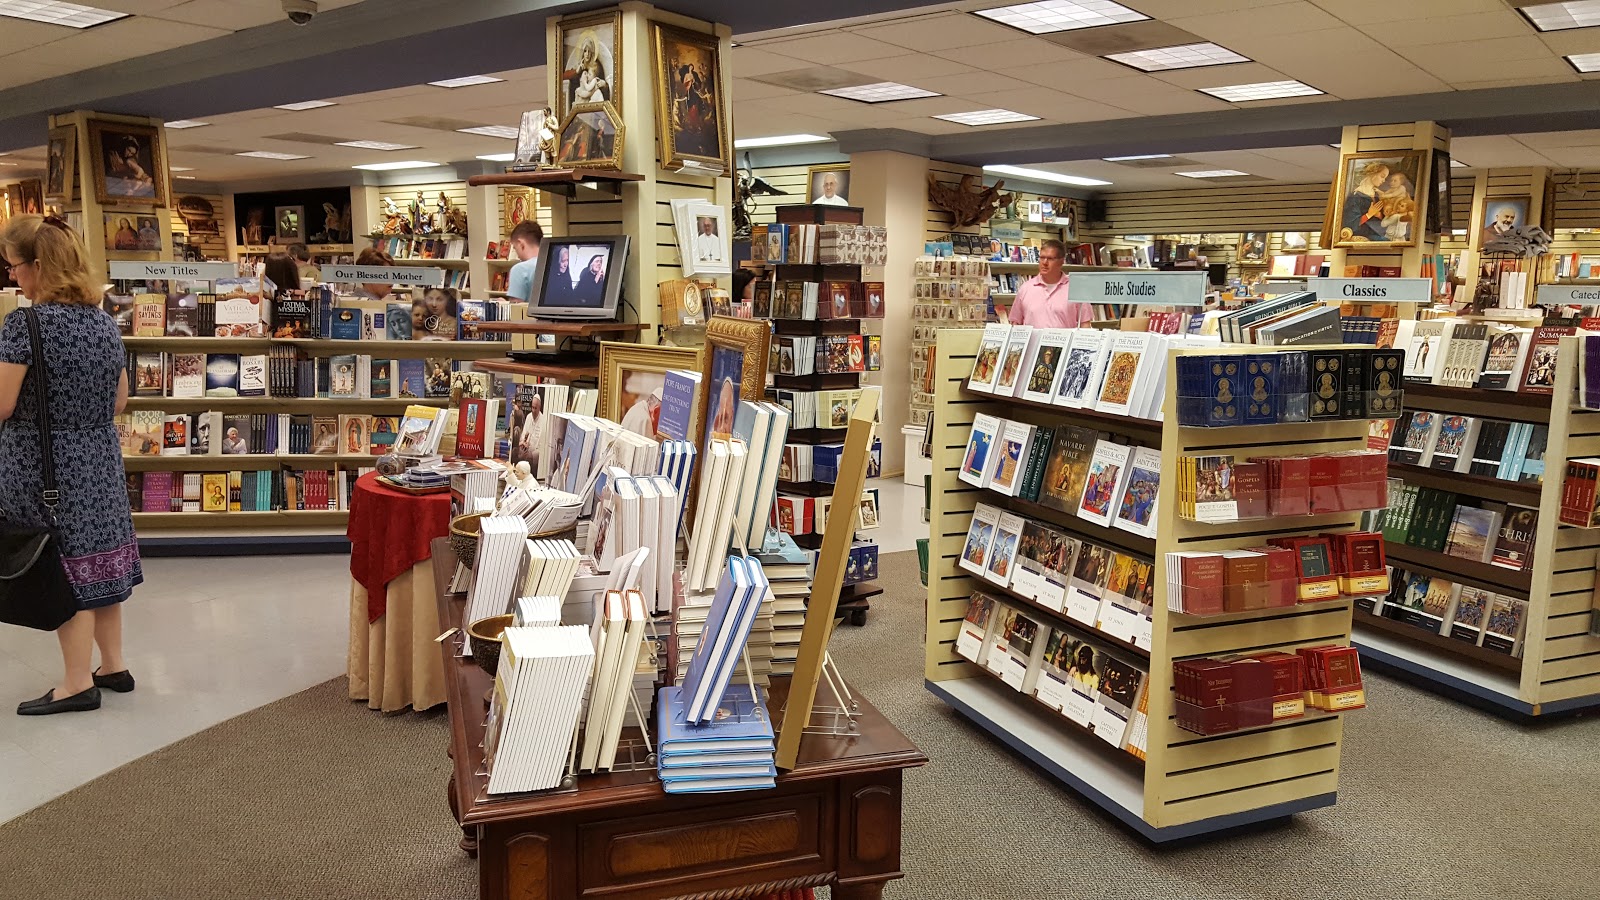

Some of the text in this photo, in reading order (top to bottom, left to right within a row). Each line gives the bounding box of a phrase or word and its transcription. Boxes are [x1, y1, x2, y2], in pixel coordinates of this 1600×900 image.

[145, 266, 198, 276] New Titles
[336, 270, 422, 282] Our Blessed Mother
[1104, 281, 1156, 296] Bible Studies
[1342, 284, 1386, 296] Classics
[1254, 312, 1274, 321] BRINGS
[459, 442, 481, 451] FATIMA
[1060, 440, 1086, 452] NAVARRE
[1061, 449, 1079, 459] BIBLE
